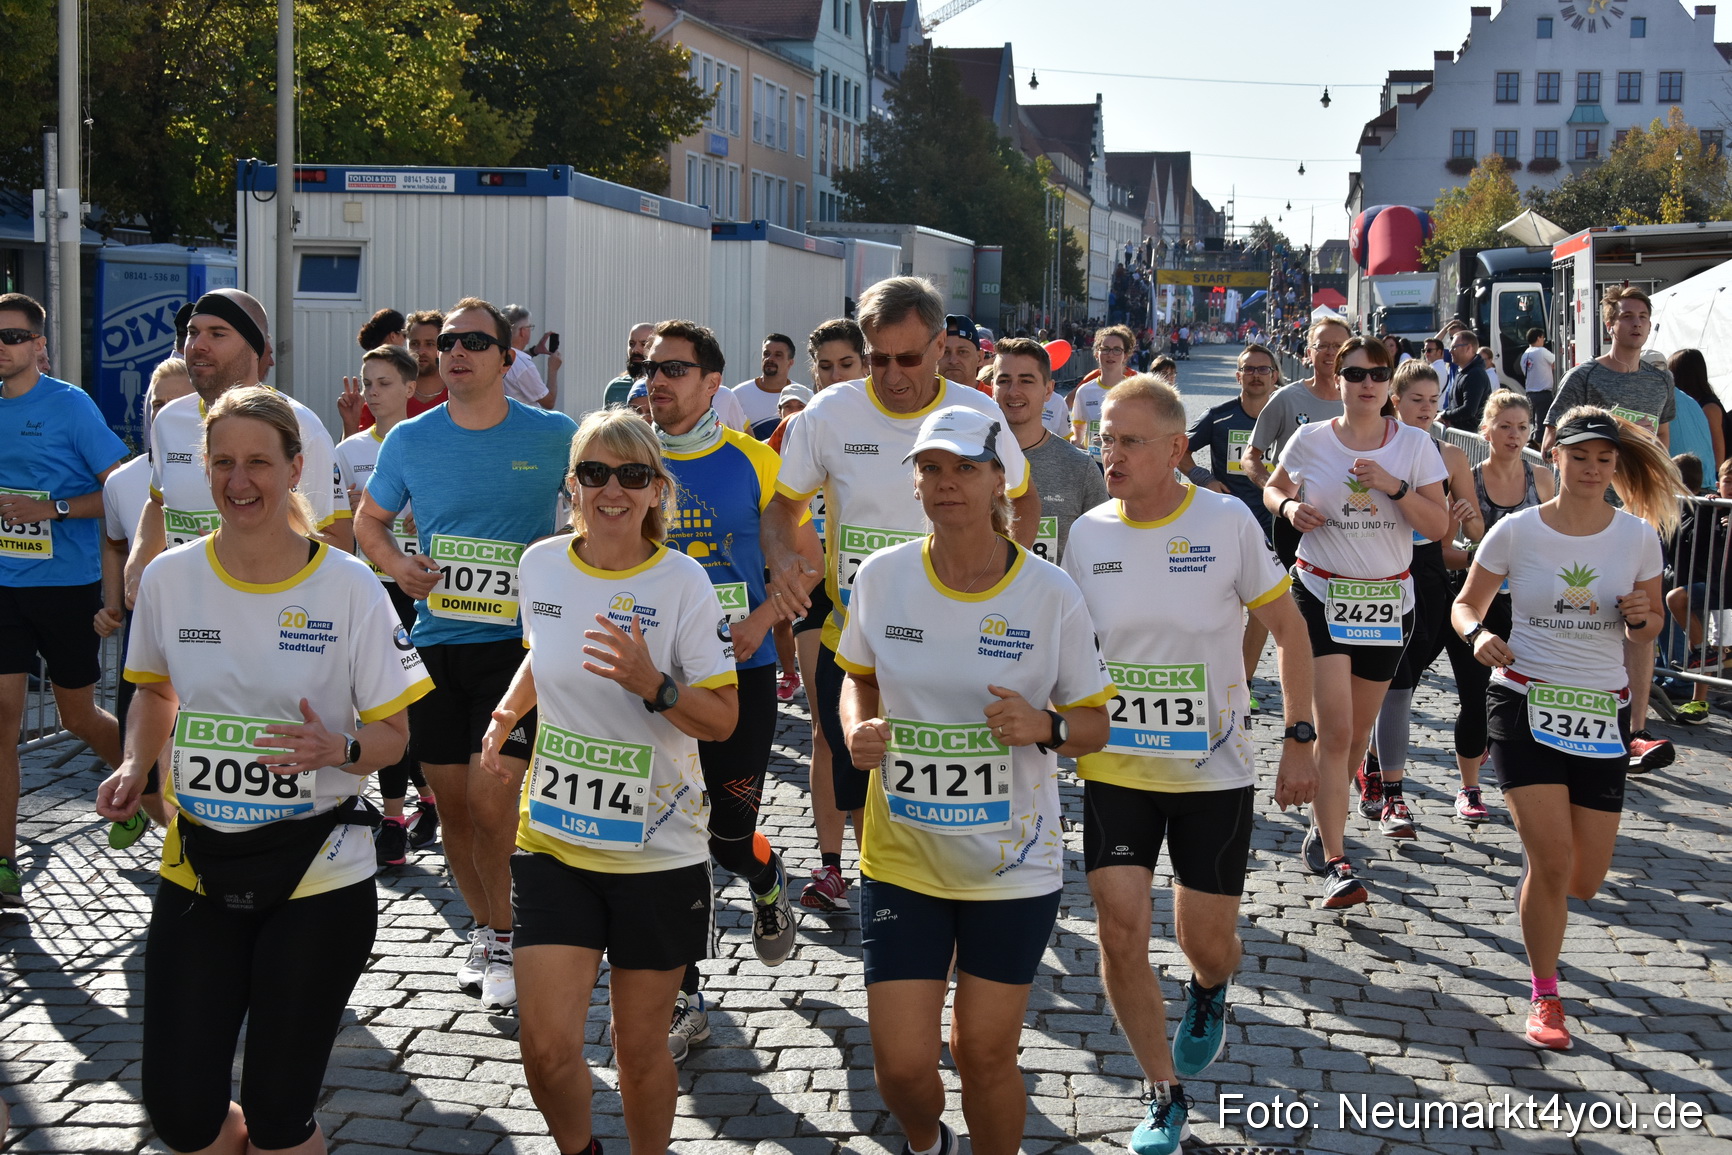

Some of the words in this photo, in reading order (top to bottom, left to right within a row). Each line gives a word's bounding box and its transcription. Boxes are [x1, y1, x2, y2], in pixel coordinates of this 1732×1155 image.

[380, 175, 396, 183] DIXI
[438, 176, 446, 184] 80
[124, 271, 147, 280] 08141
[154, 272, 168, 281] 536
[169, 273, 179, 282] 80
[1193, 273, 1232, 284] START
[845, 443, 879, 452] BOCK
[167, 452, 192, 462] BOCK
[1326, 518, 1360, 530] GESUND
[1362, 521, 1381, 529] UND
[1383, 521, 1396, 530] FIT
[438, 538, 518, 564] BOCK
[1169, 541, 1189, 554] 20
[1093, 561, 1123, 572] BOCK
[1169, 555, 1216, 564] Neumarkter
[1169, 564, 1207, 573] Stadtlauf
[440, 565, 511, 596] 1073
[1333, 582, 1397, 598] BOCK
[441, 598, 503, 614] DOMINIC
[533, 601, 562, 615] BOCK
[611, 596, 634, 611] 20
[635, 606, 654, 614] JAHRE
[1334, 603, 1393, 622] 2429
[281, 611, 306, 628] 20
[982, 618, 1006, 636] 20
[1529, 617, 1574, 629] GESUND
[1578, 620, 1601, 630] UND
[1603, 621, 1618, 630] FIT
[179, 628, 221, 640] BOCK
[280, 630, 338, 643] Neumarkter
[885, 625, 924, 640] BOCK
[1346, 629, 1381, 638] DORIS
[1573, 632, 1593, 640] Julia
[279, 642, 326, 655] Stadtlauf
[980, 636, 1034, 650] Neumarkter
[977, 647, 1023, 661] Stadtlauf
[1109, 665, 1197, 689] BOCK
[1535, 687, 1612, 714] BOCK
[1110, 694, 1194, 726] 2113
[1538, 710, 1607, 739] 2347
[891, 723, 999, 753] BOCK
[1134, 732, 1171, 746] UWE
[1210, 723, 1234, 753] September
[542, 729, 642, 773] BOCK
[1556, 740, 1598, 752] JULIA
[189, 755, 299, 799] 2098
[895, 760, 992, 796] 2121
[541, 765, 632, 814] 2114
[674, 785, 690, 801] 2019
[194, 801, 295, 821] SUSANNE
[905, 804, 989, 822] CLAUDIA
[561, 814, 600, 836] LISA
